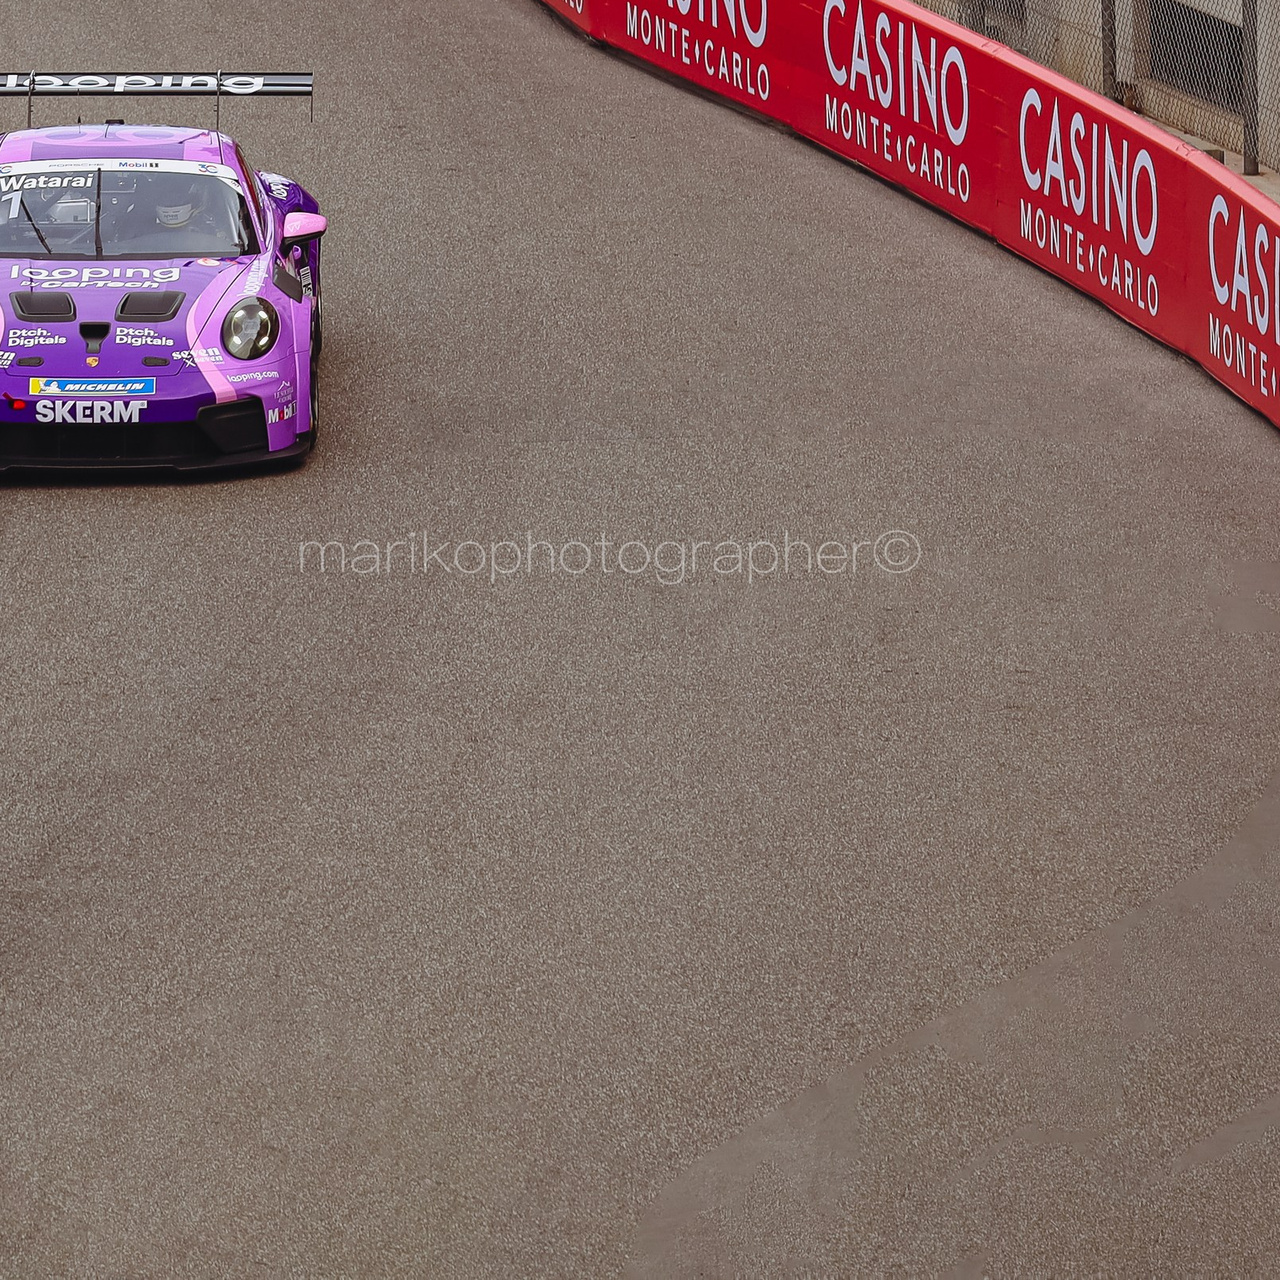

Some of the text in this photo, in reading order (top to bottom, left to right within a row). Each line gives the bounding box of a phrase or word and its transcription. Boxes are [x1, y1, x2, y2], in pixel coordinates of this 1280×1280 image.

[626, 1, 771, 102] MONTE CARLO
[5, 74, 265, 94] looping
[825, 93, 971, 205] MONTE CARLO
[1019, 87, 1158, 257] CASINO
[0, 173, 94, 192] Watarai
[1020, 197, 1159, 318] MONTE CARLO
[10, 264, 181, 282] looping
[8, 327, 52, 338] Dtch.
[8, 335, 67, 347] Digitals
[115, 336, 174, 346] Digitals
[116, 327, 158, 337] Dtch.
[172, 347, 221, 361] seven
[1209, 313, 1269, 396] MONTE
[226, 370, 280, 383] looping.com
[64, 383, 146, 391] MICHELIN
[268, 405, 292, 425] Mobil
